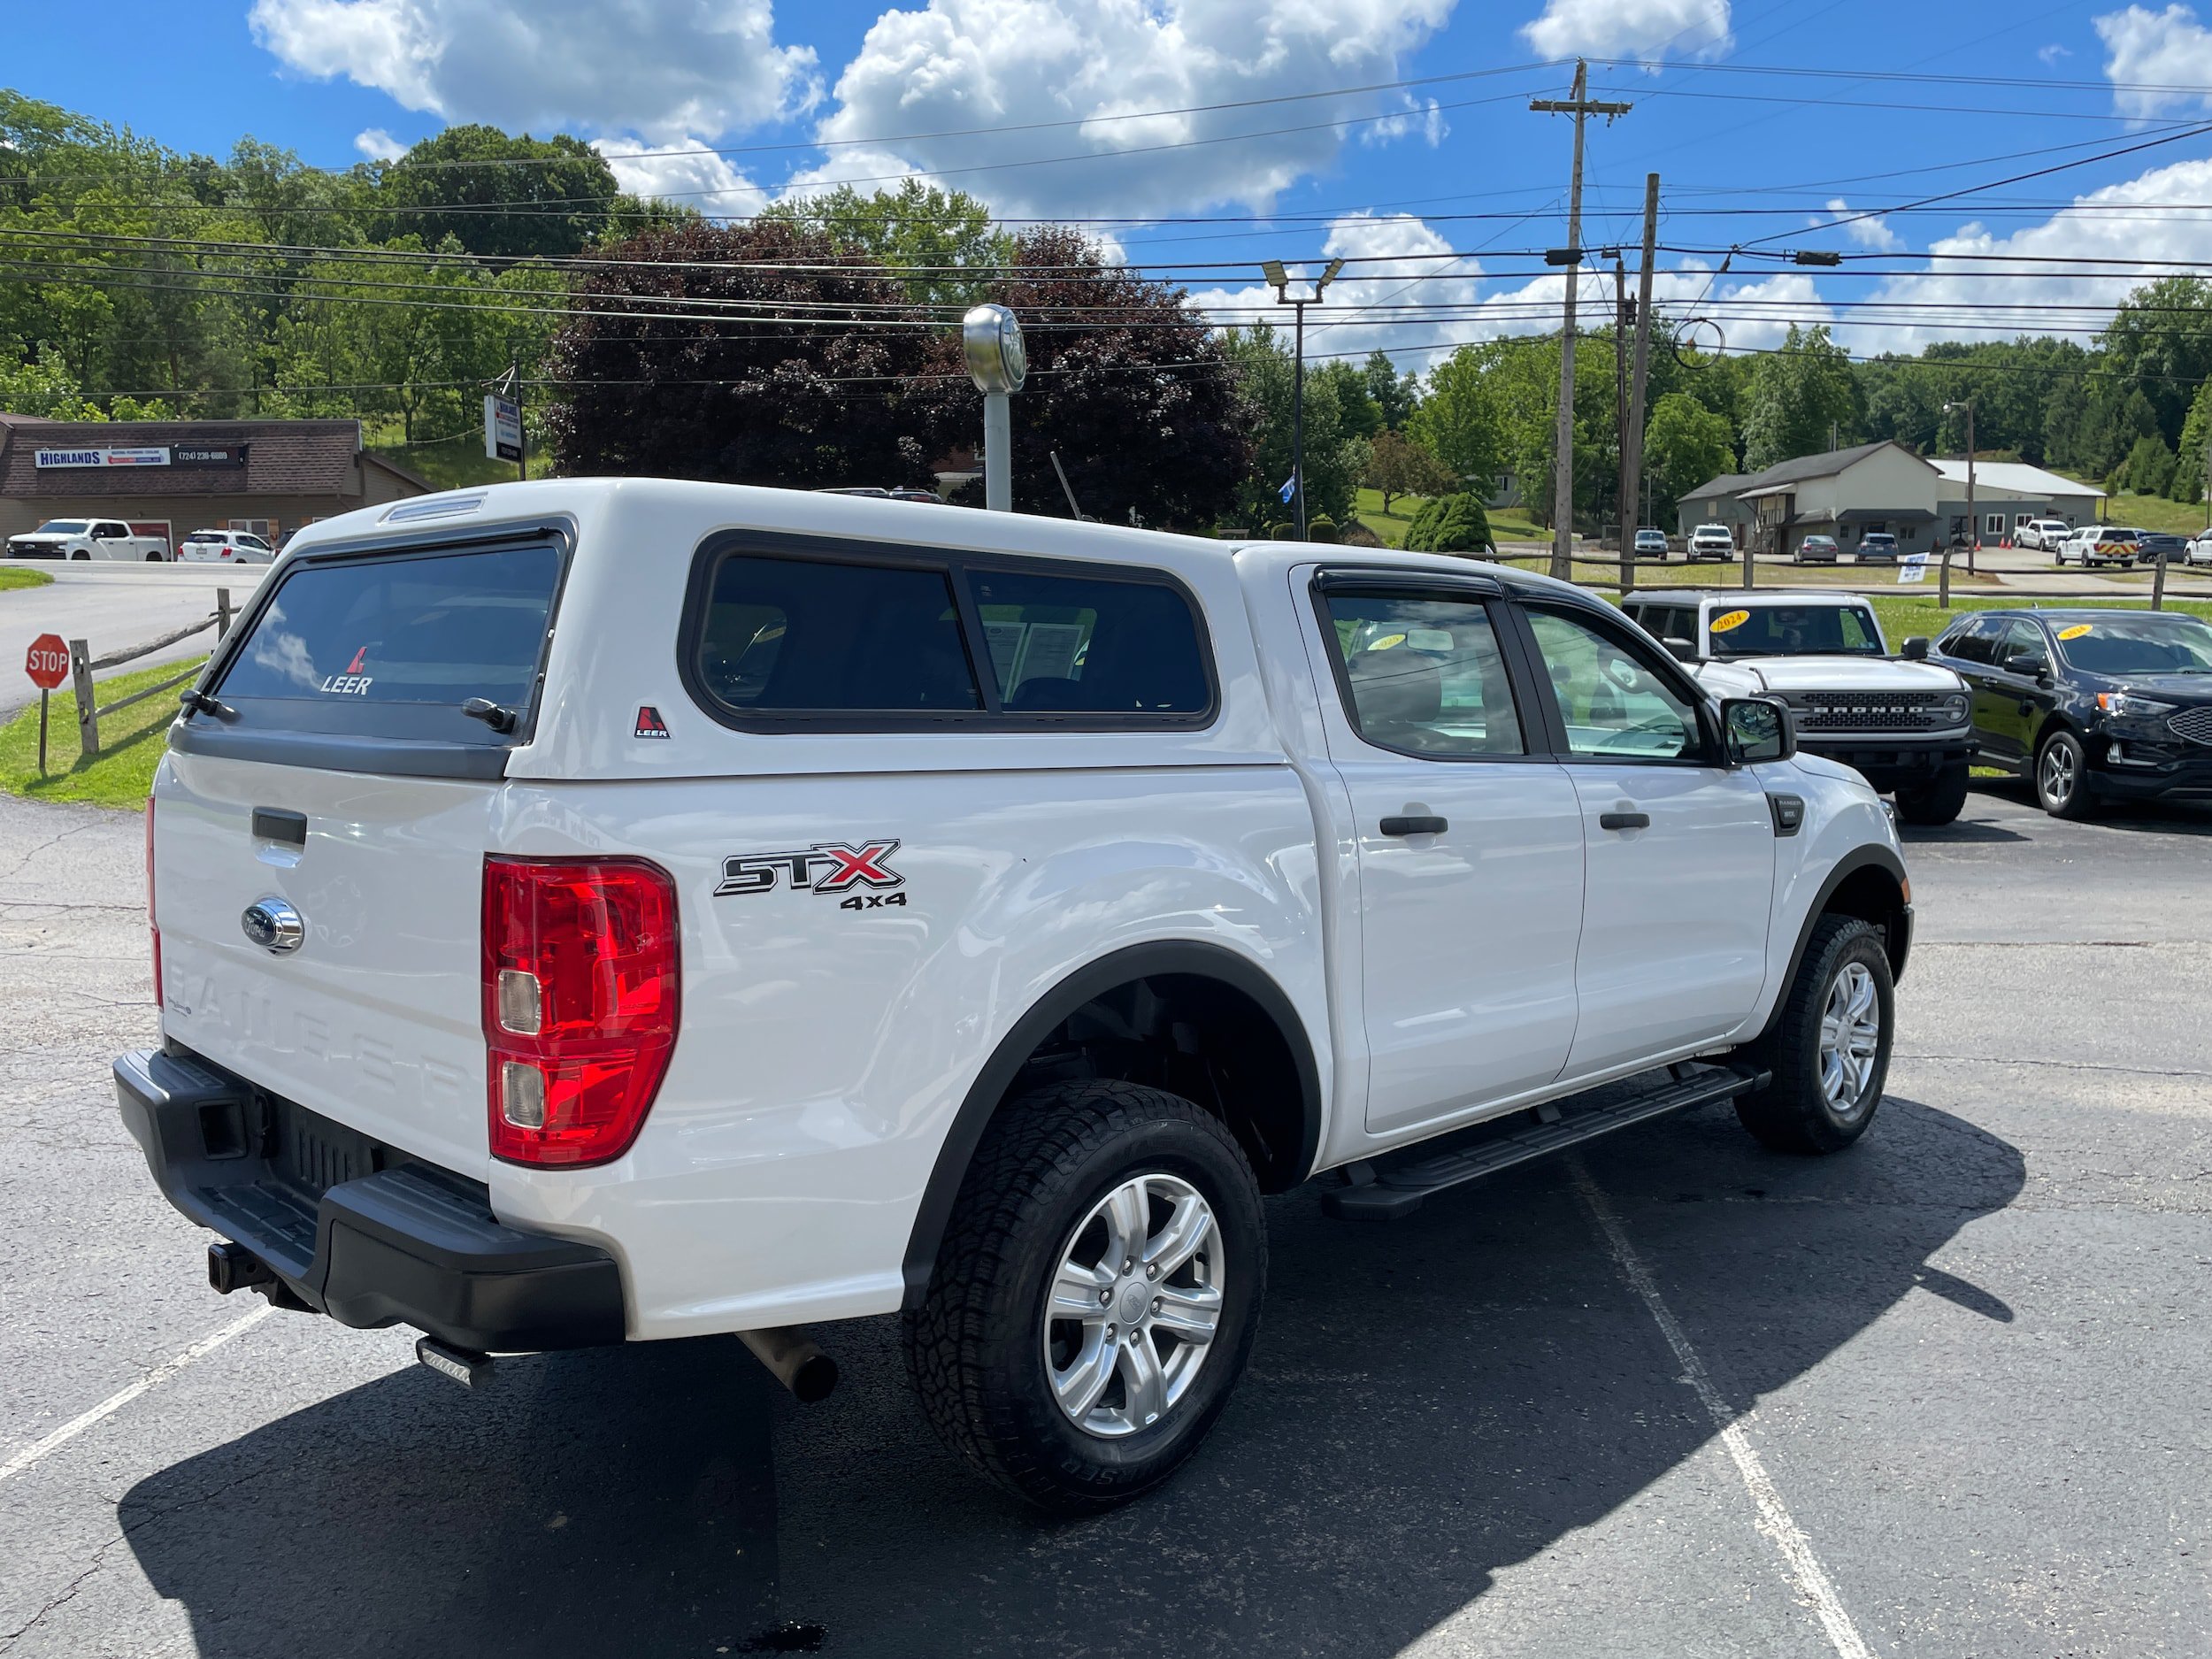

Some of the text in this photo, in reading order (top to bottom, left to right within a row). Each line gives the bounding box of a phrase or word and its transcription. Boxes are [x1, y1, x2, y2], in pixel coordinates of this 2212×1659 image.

[40, 451, 100, 465] HIGHLANDS
[179, 451, 196, 461] (724)
[1719, 612, 1742, 629] 2024
[29, 649, 68, 672] STOP
[319, 675, 373, 695] LEER
[712, 838, 906, 898] STX
